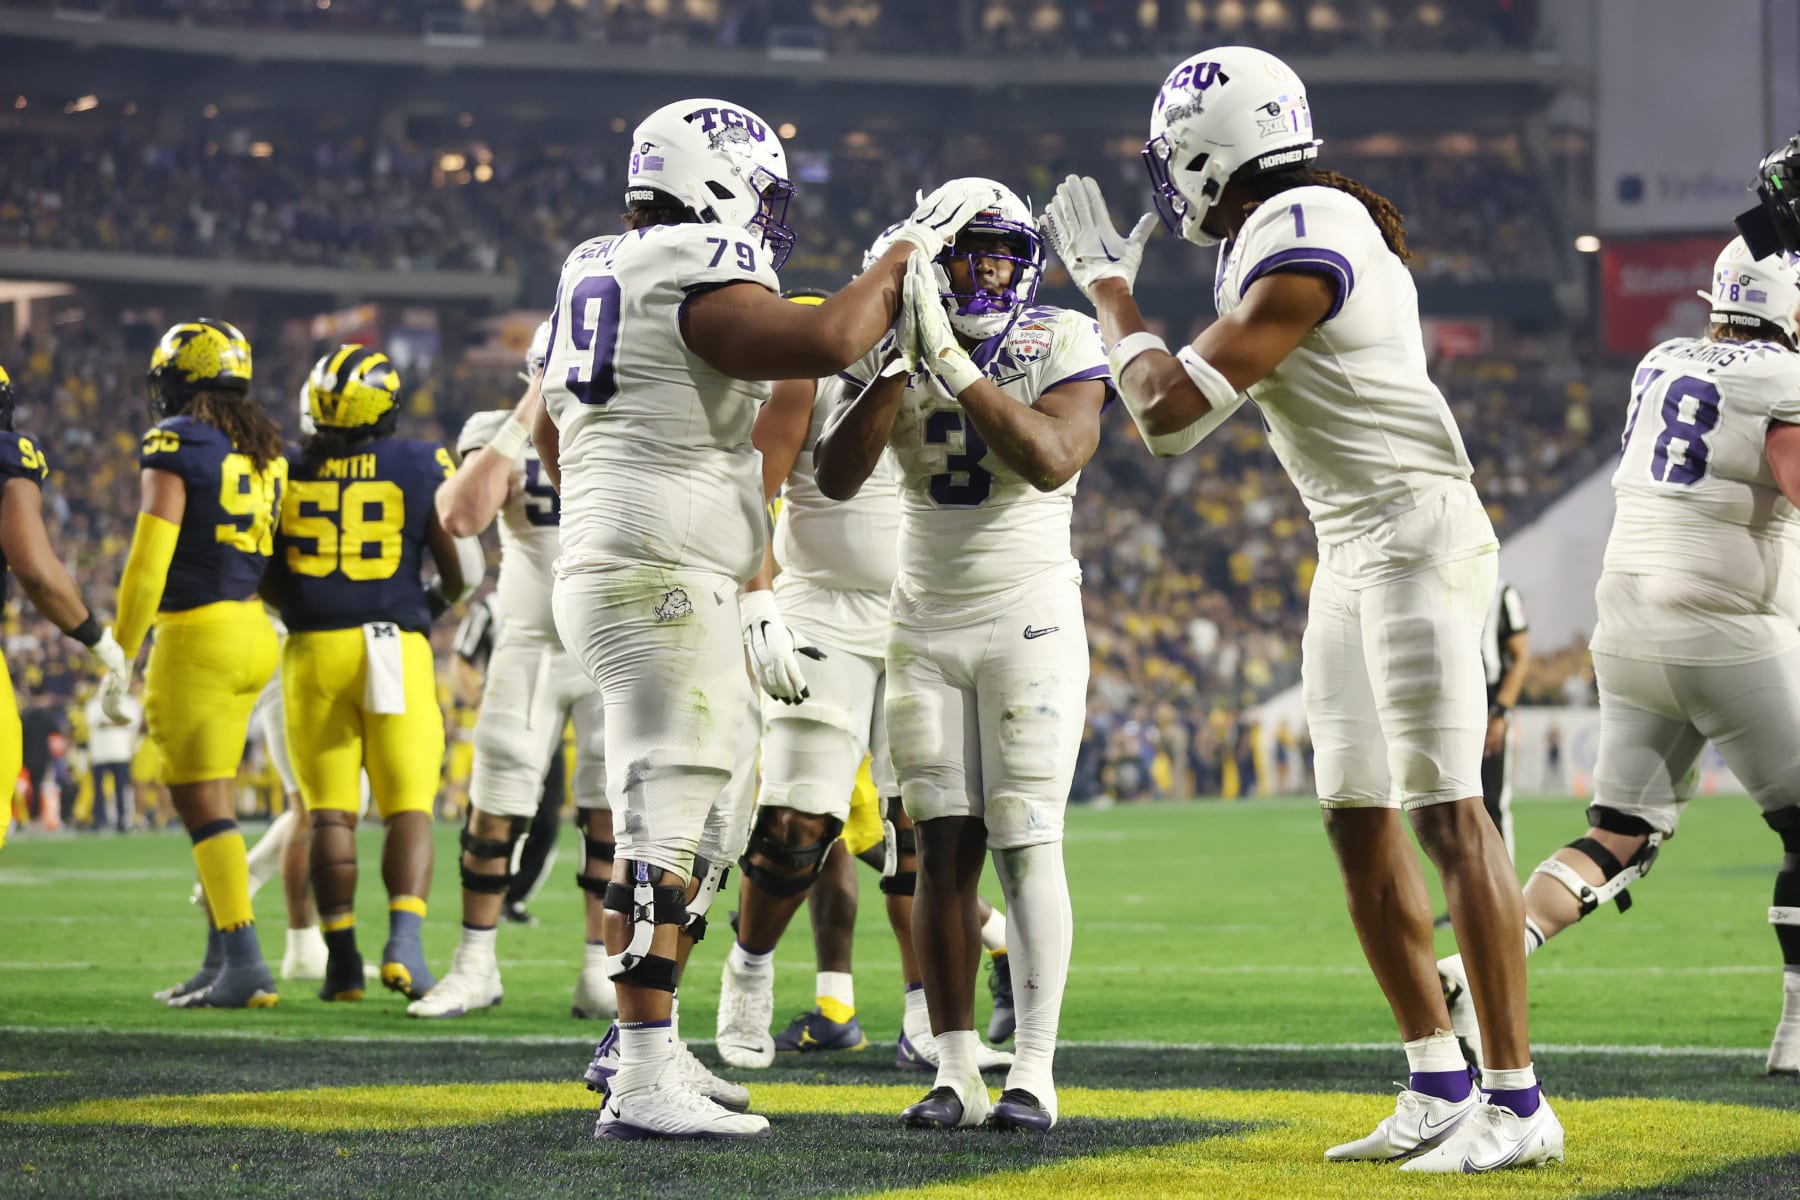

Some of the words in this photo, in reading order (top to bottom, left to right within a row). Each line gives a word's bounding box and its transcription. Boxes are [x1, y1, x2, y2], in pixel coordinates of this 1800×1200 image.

[693, 107, 767, 142] TCU
[1259, 150, 1302, 169] HORNED
[630, 190, 654, 201] FROGS
[1289, 203, 1306, 238] 1
[706, 237, 757, 273] 79
[1719, 282, 1740, 302] 78
[1730, 314, 1761, 327] FROGS
[926, 410, 992, 506] 3
[281, 480, 405, 581] 58
[373, 625, 395, 640] M
